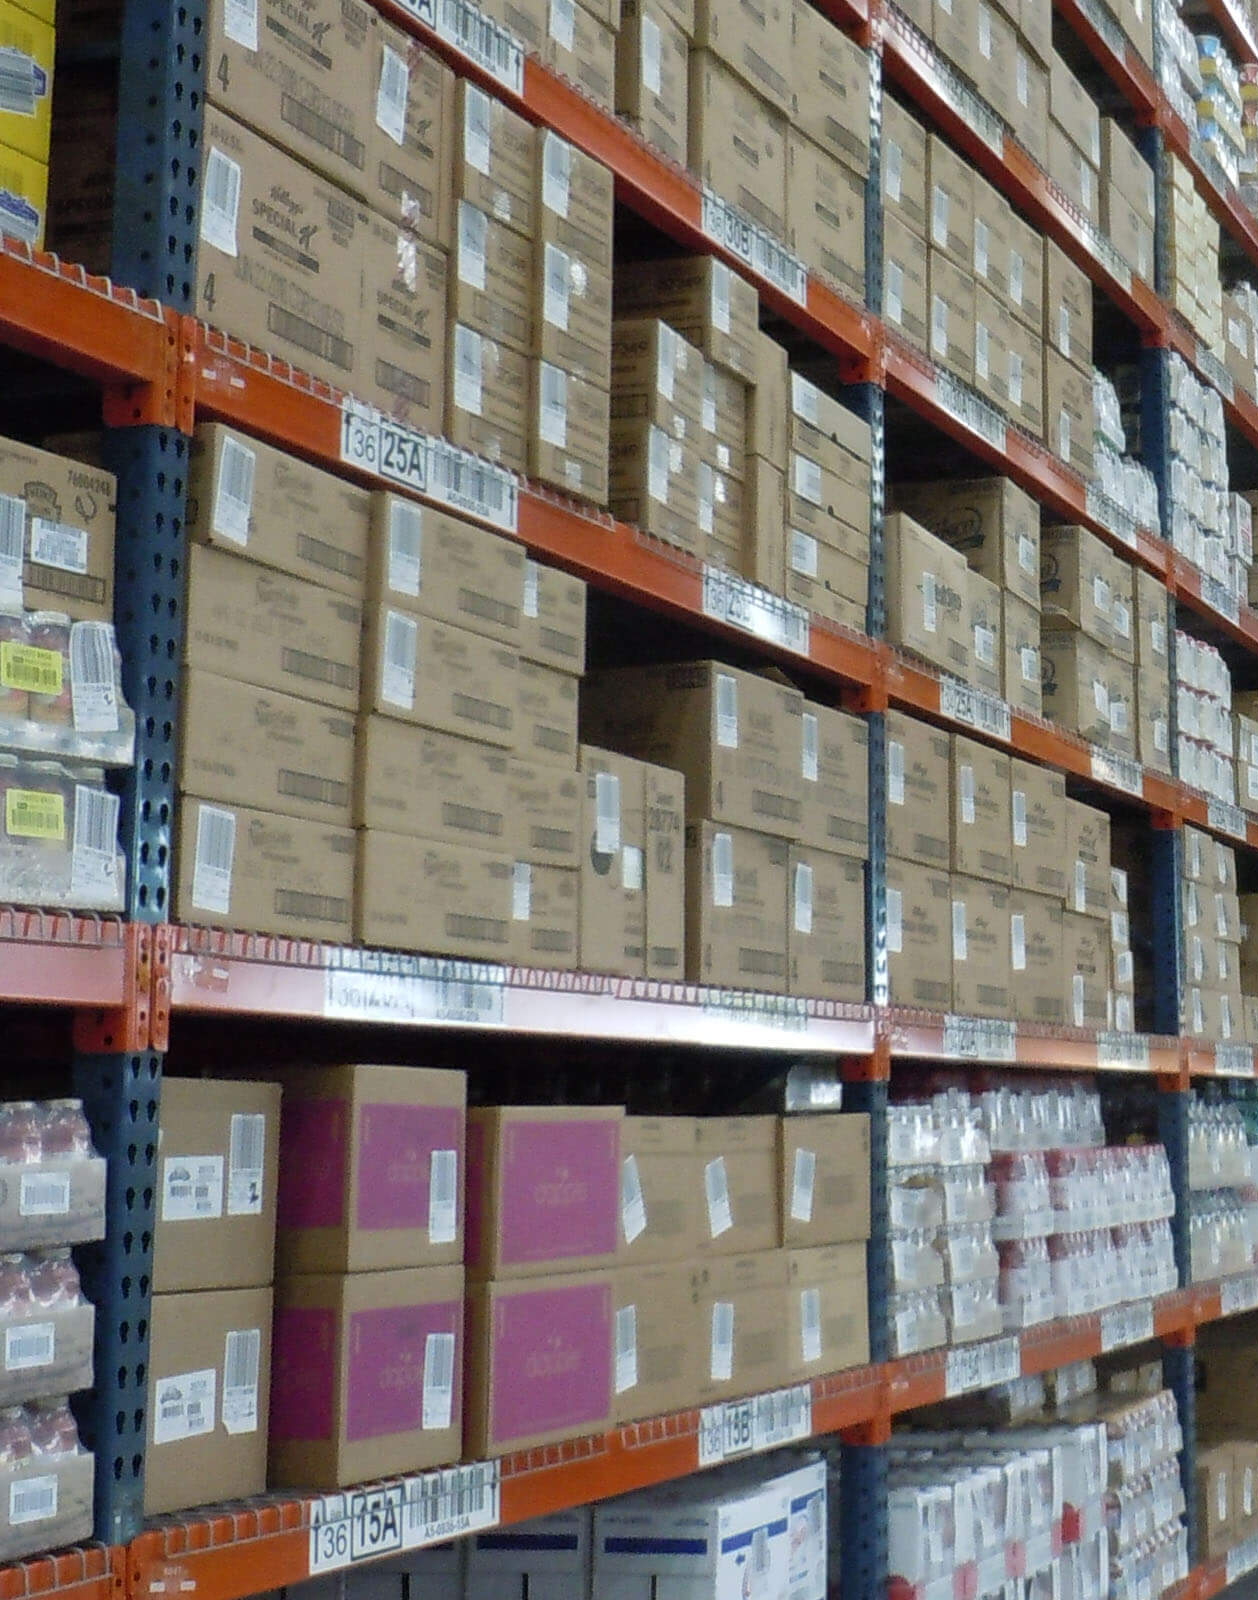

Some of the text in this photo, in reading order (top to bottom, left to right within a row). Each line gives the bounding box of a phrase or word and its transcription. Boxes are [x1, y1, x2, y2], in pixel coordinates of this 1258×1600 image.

[353, 428, 423, 481] 36 25A
[323, 1497, 398, 1559] 36 15A
